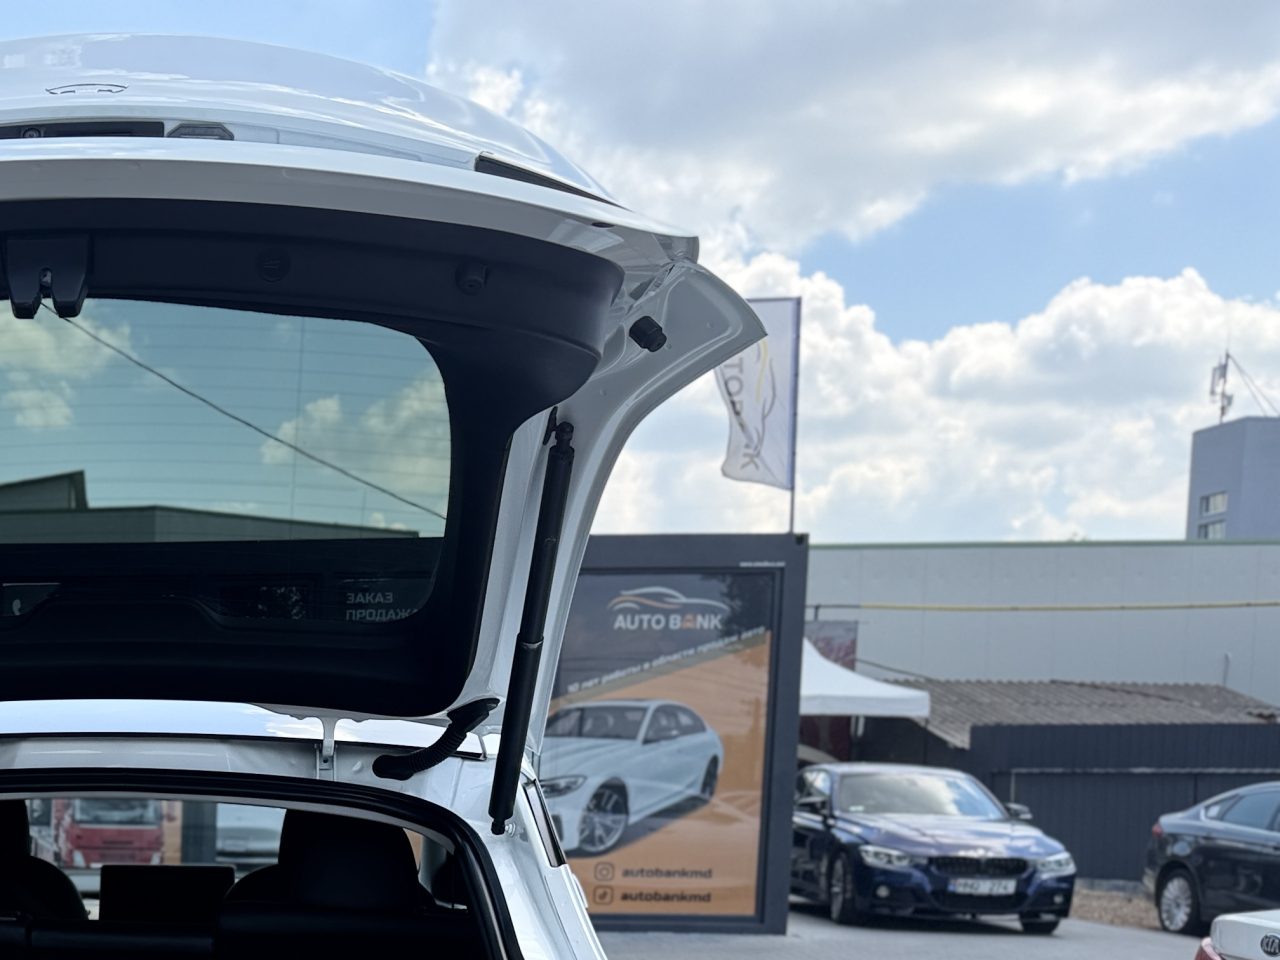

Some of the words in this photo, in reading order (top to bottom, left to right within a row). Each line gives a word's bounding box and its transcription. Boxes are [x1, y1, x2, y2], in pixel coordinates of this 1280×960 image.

[345, 591, 394, 604] ЗАКАЗ
[613, 614, 666, 630] AUTO
[669, 614, 723, 630] BANK
[622, 867, 713, 879] autobankmd
[620, 890, 712, 902] autobankmd
[1262, 937, 1279, 953] KIA
